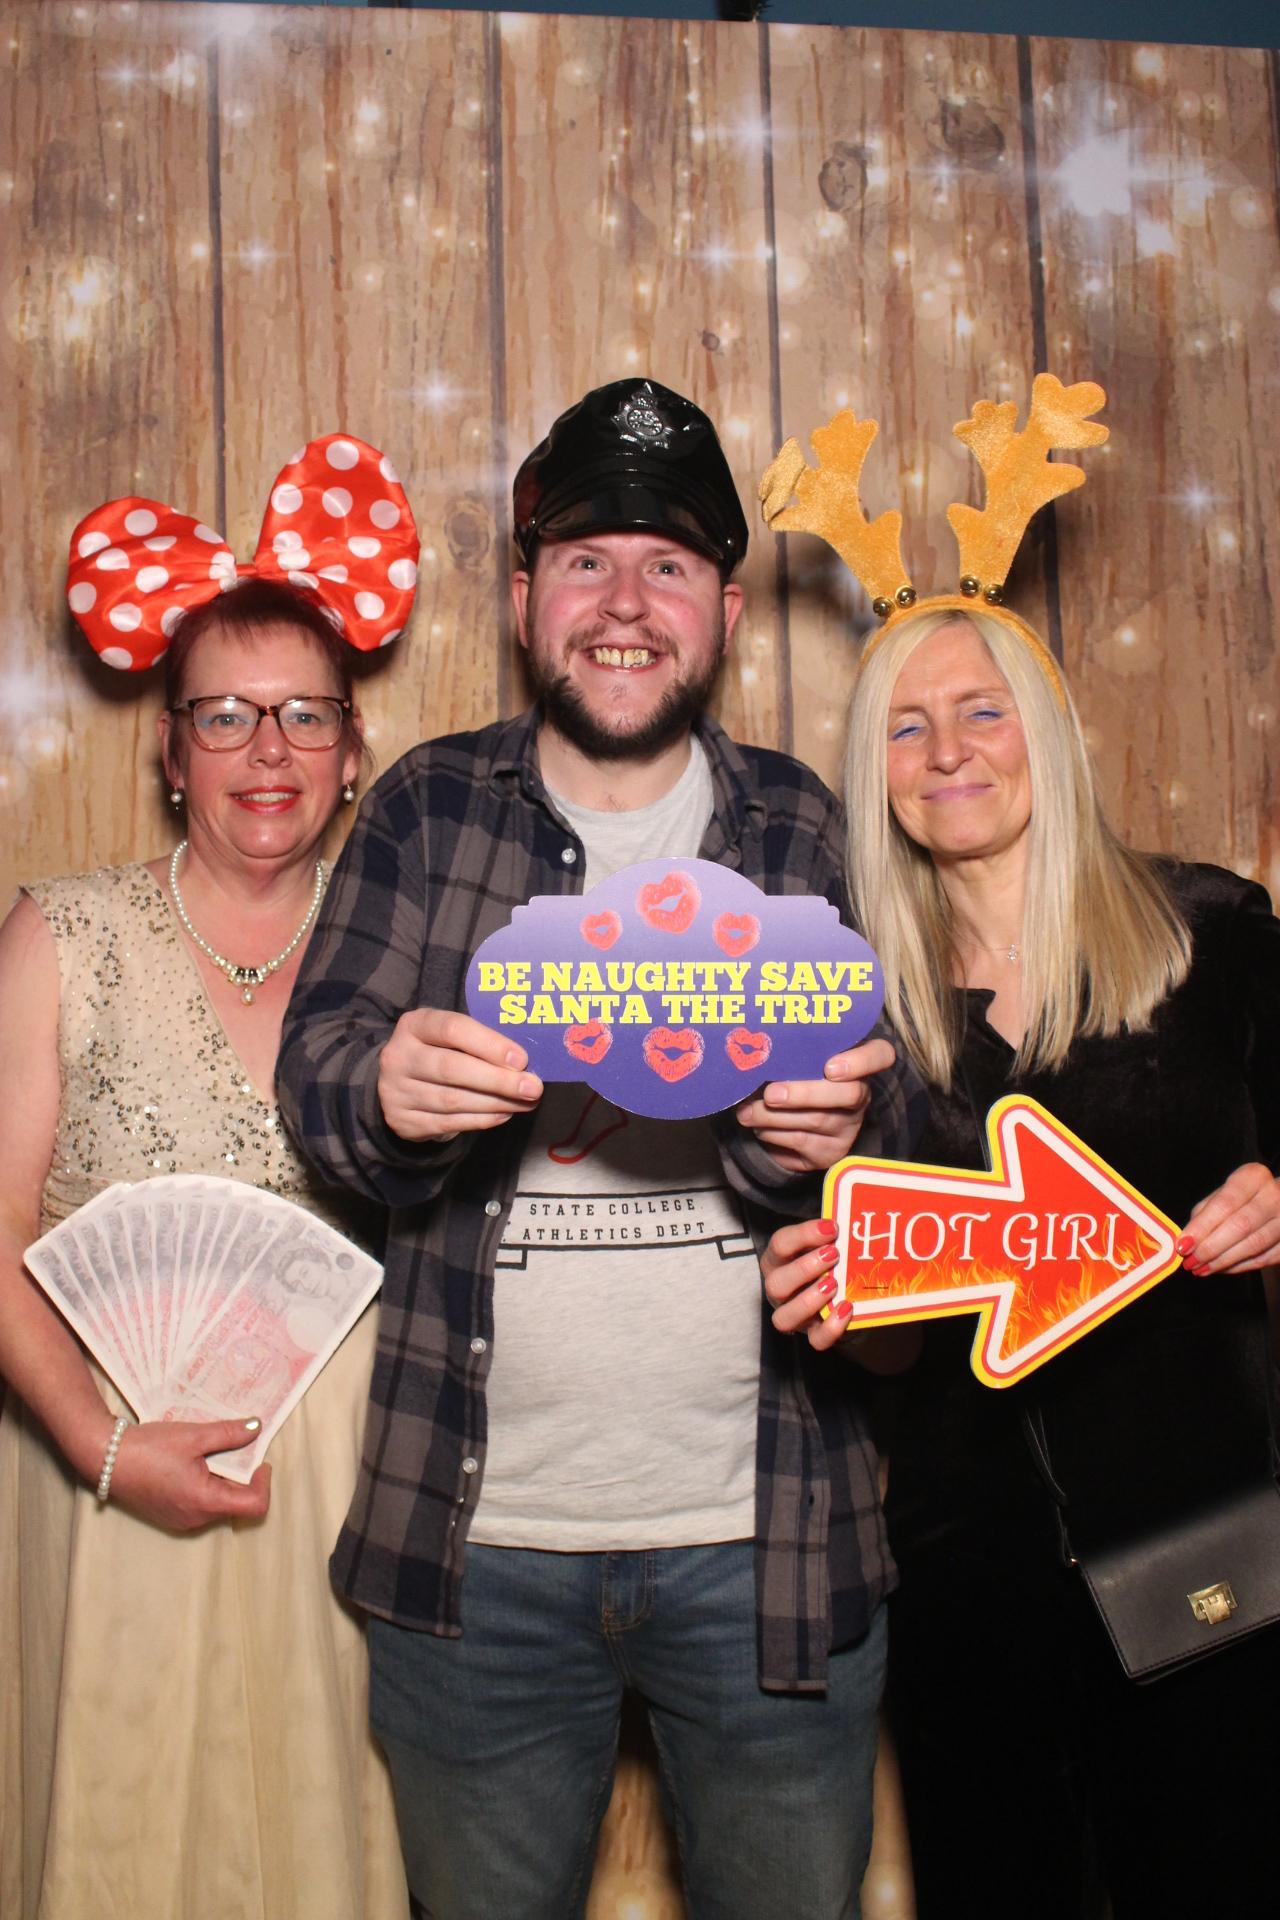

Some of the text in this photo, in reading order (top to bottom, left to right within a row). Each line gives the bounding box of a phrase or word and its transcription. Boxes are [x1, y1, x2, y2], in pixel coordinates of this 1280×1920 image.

[478, 961, 873, 992] BE NAUGHTY SAVE
[500, 994, 853, 1025] SANTA THE TRIP
[530, 1198, 695, 1216] STATE COLLEGE
[522, 1222, 705, 1241] ATHLETICS DEPT
[851, 1211, 1131, 1271] HOT GIRL
